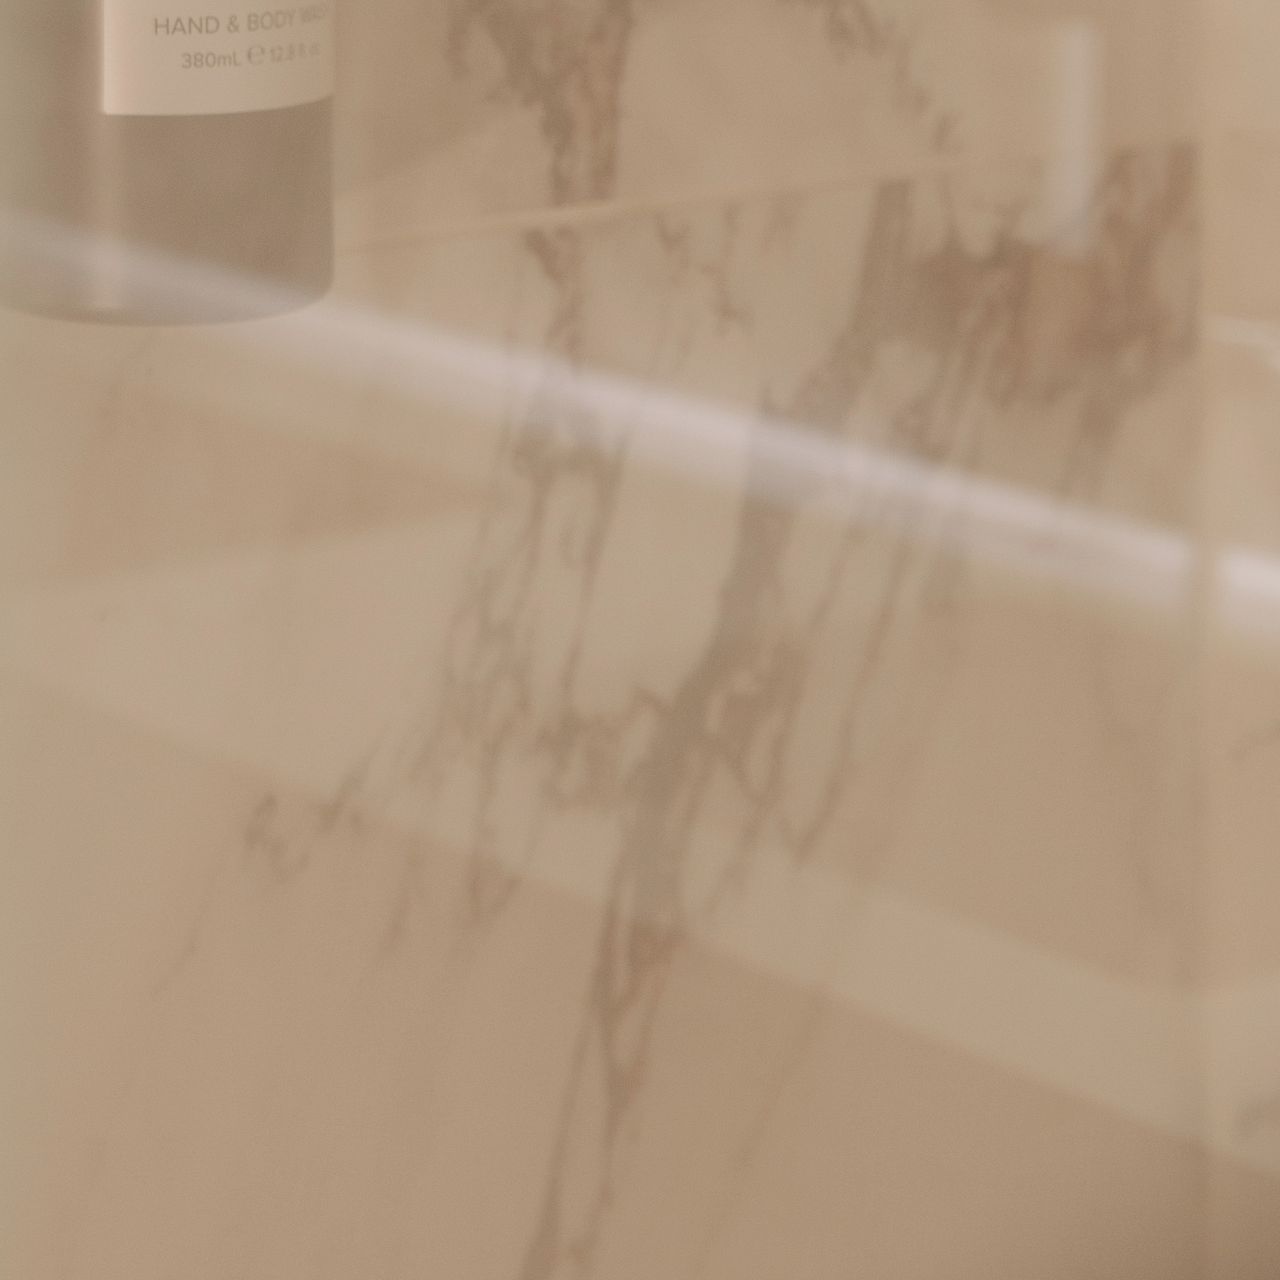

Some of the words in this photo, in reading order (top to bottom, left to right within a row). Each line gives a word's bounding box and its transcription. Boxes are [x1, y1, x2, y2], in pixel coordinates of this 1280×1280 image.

[153, 15, 220, 37] HAND
[226, 14, 241, 35] &
[247, 9, 297, 33] BODY
[181, 50, 242, 70] 380mL
